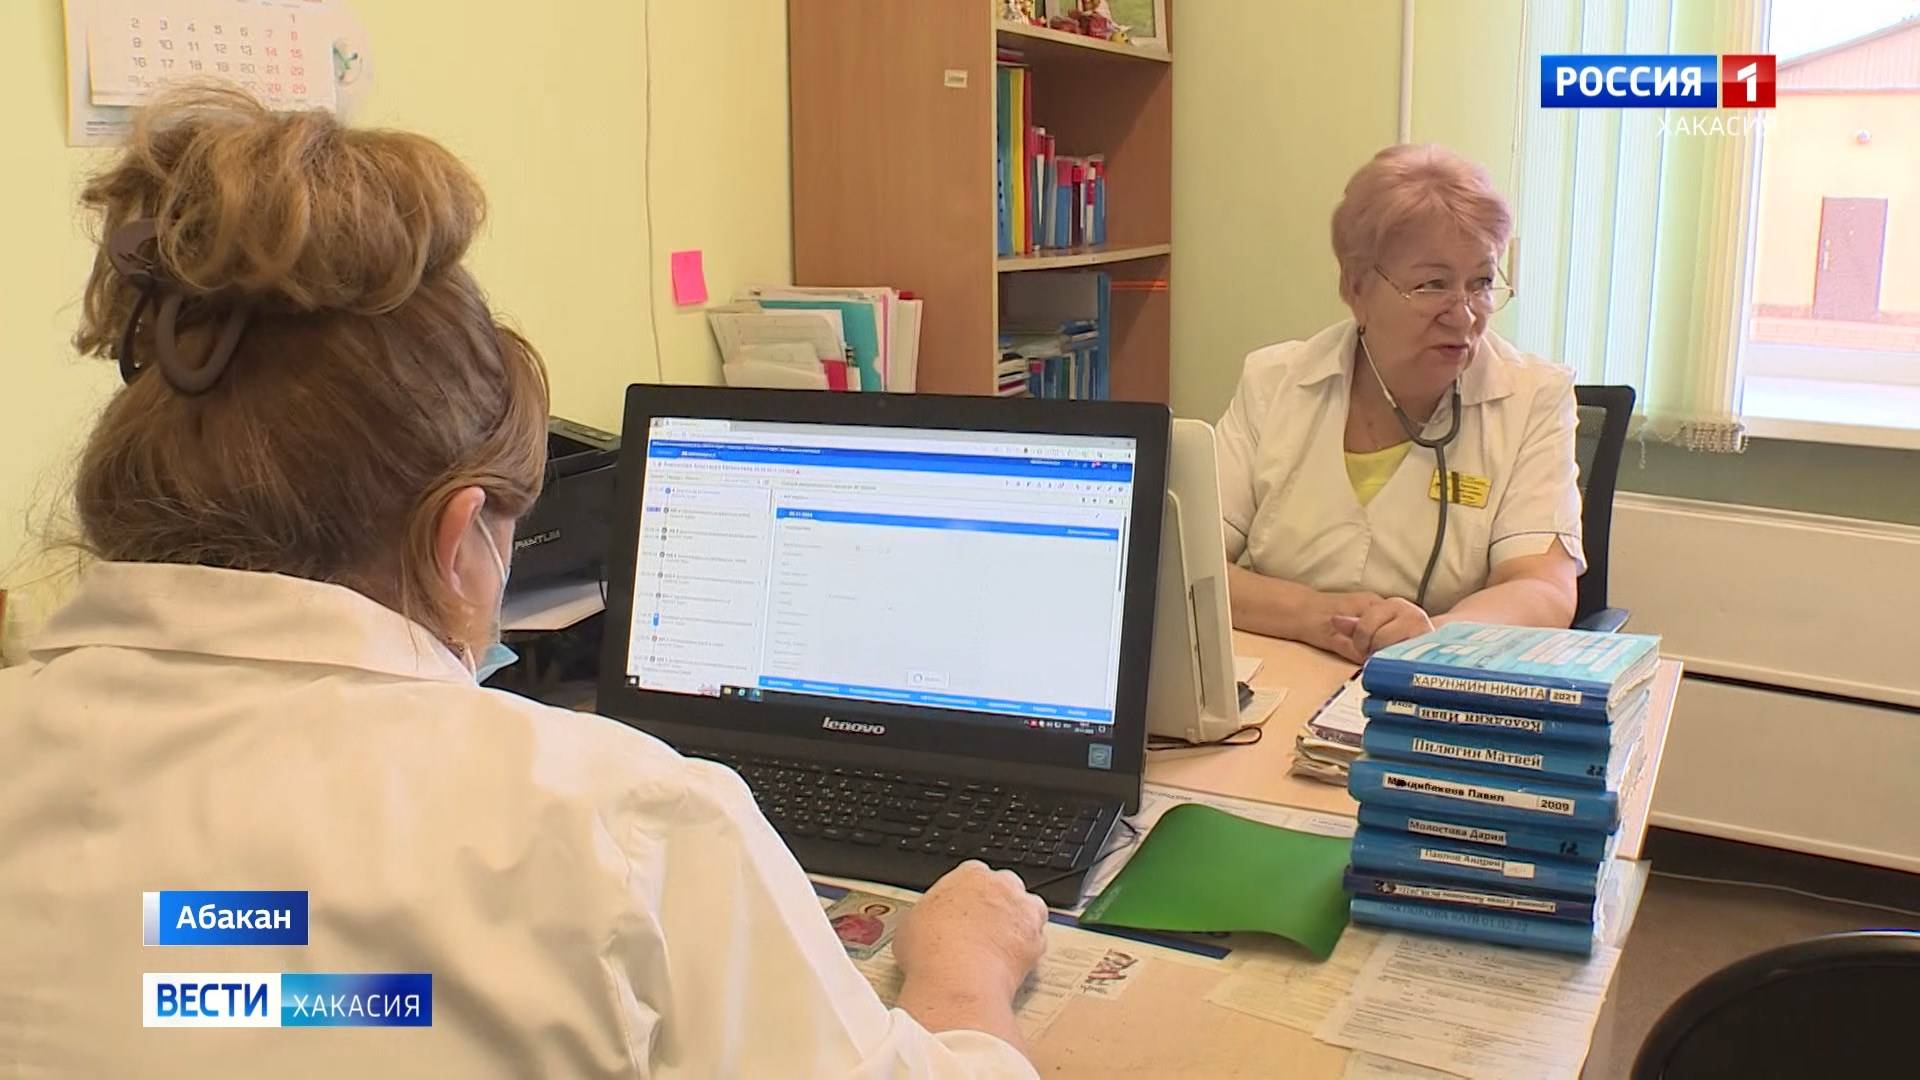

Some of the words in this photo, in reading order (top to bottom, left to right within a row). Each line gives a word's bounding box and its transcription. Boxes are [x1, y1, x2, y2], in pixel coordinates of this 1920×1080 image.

[130, 18, 140, 28] 2
[159, 19, 168, 30] 3
[187, 23, 195, 32] 4
[214, 25, 223, 35] 5
[265, 29, 273, 39] 7
[158, 39, 173, 50] 10
[188, 41, 199, 51] 11
[214, 43, 227, 54] 12
[265, 47, 277, 57] 14
[133, 57, 146, 68] 16
[161, 59, 174, 69] 17
[240, 63, 255, 74] 20
[515, 529, 560, 550] PANTUM
[1414, 675, 1488, 692] ХАРУНЖИН
[1492, 683, 1545, 698] НИКИТА
[1553, 691, 1577, 702] 2021
[822, 716, 885, 735] lenovo
[1421, 709, 1459, 723] Иван
[1414, 739, 1480, 758] Пилюгин
[1484, 750, 1541, 767] Матвей
[1541, 799, 1570, 812] 2009
